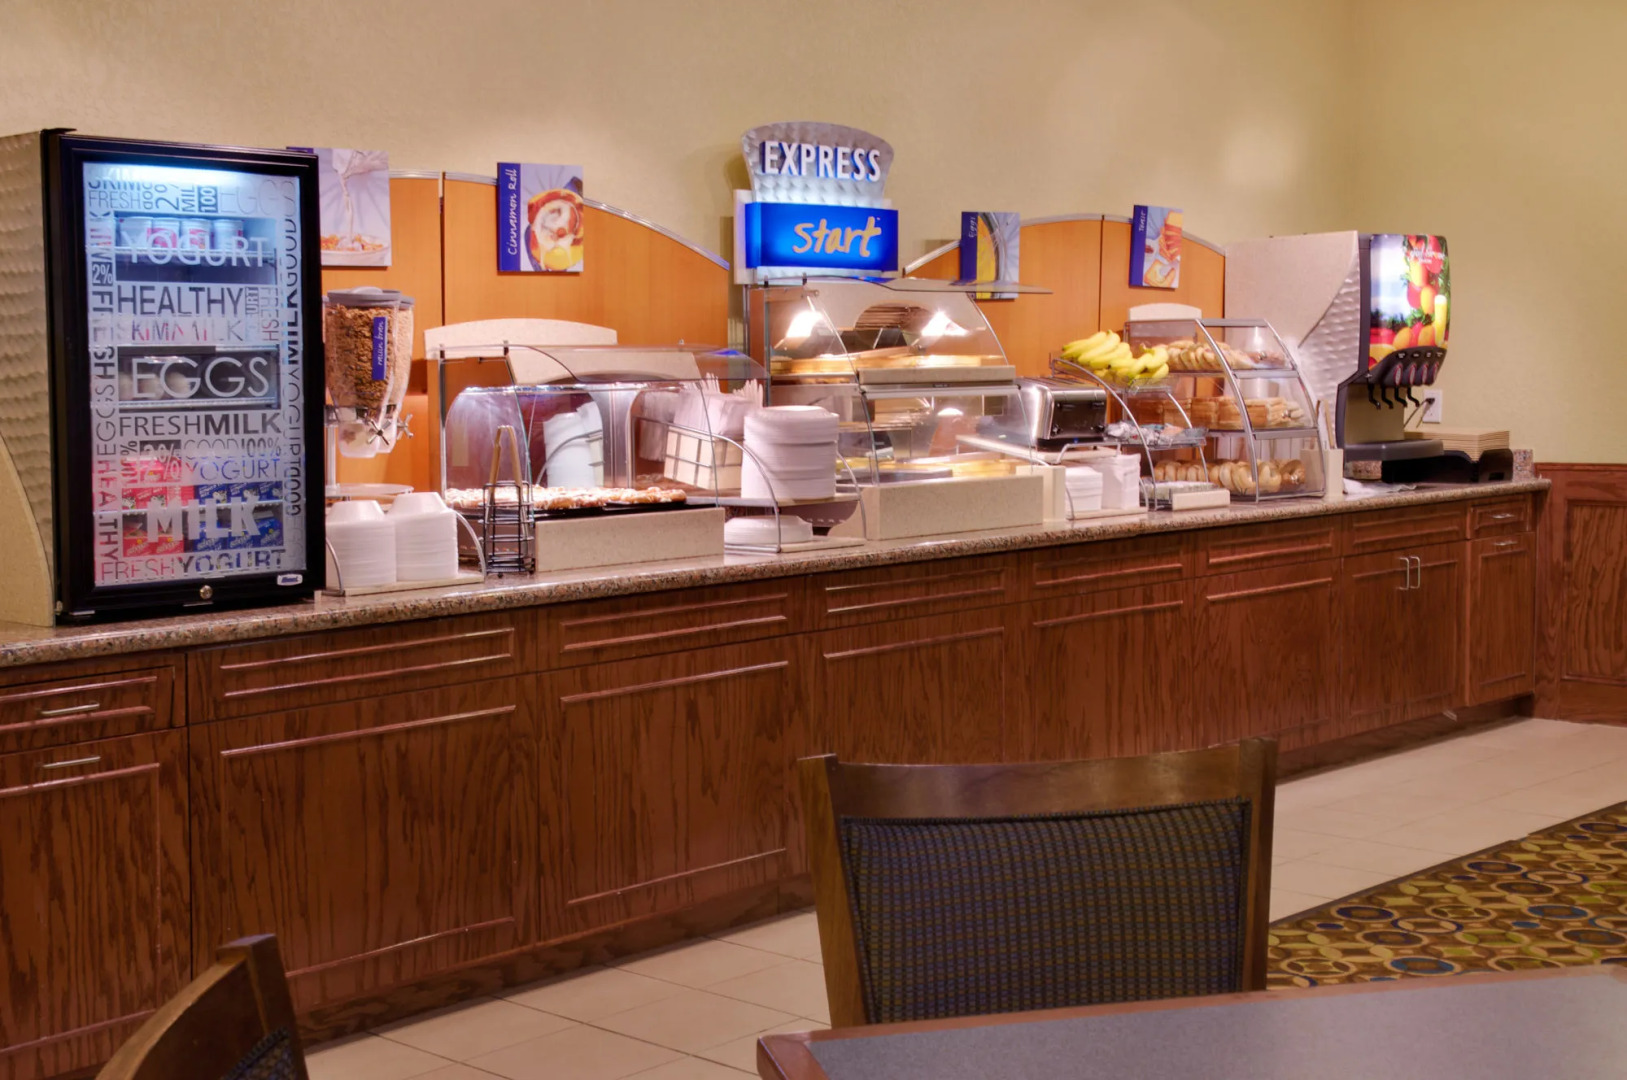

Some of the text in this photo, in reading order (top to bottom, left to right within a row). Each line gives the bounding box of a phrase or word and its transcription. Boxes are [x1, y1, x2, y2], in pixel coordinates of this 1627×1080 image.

[761, 140, 881, 182] EXPRESS
[88, 190, 141, 209] FRESH
[181, 184, 196, 213] MIL
[505, 168, 518, 255] Cinnamon Roll
[119, 230, 268, 268] YOGURT
[117, 285, 244, 315] HEALTHY
[132, 356, 270, 398] EGGS
[119, 412, 282, 437] FRESH MILK
[185, 459, 281, 481] YOGURT
[147, 495, 261, 543] MILK
